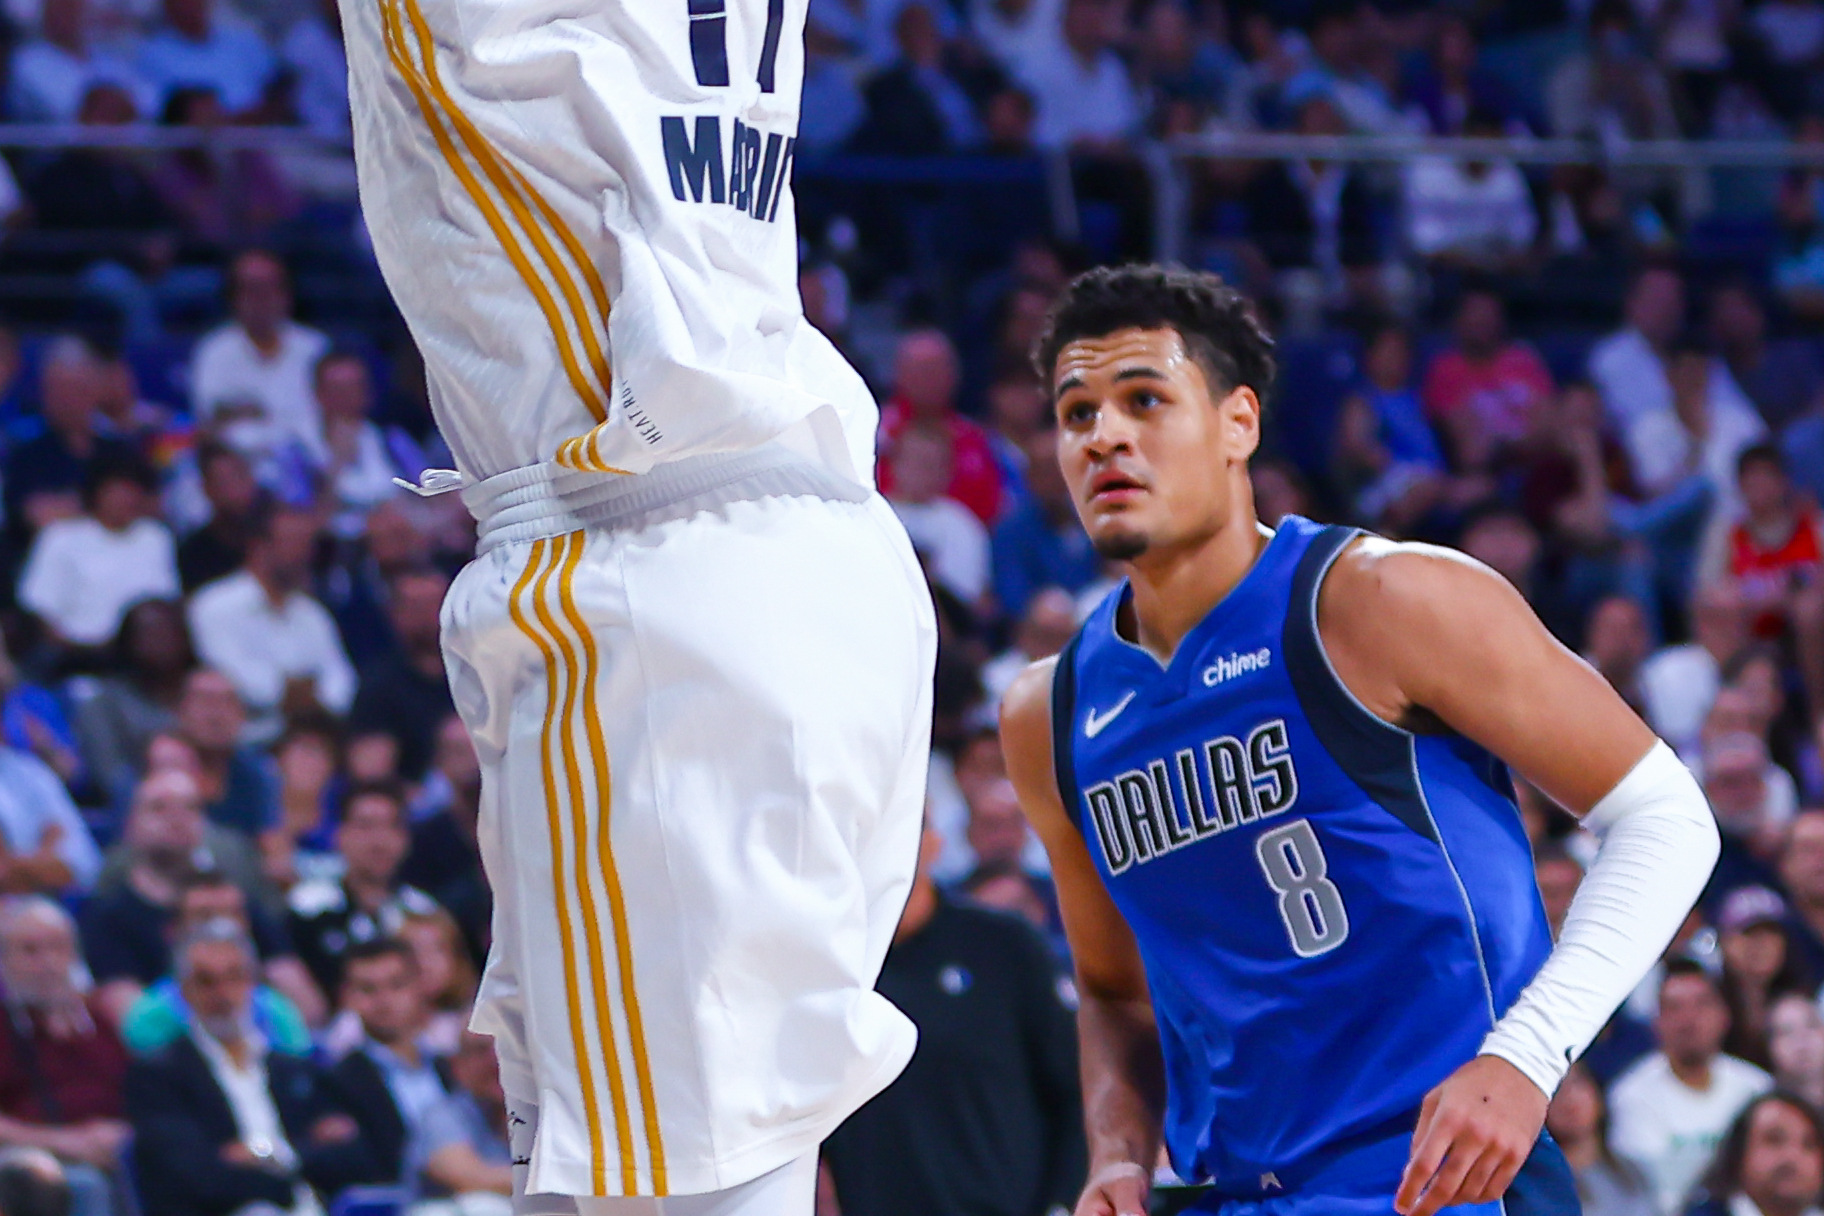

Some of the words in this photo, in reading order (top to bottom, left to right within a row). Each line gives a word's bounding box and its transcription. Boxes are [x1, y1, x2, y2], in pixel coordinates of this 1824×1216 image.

[1202, 647, 1271, 688] chime
[1085, 719, 1298, 877] DALLAS
[1256, 818, 1350, 959] 8
